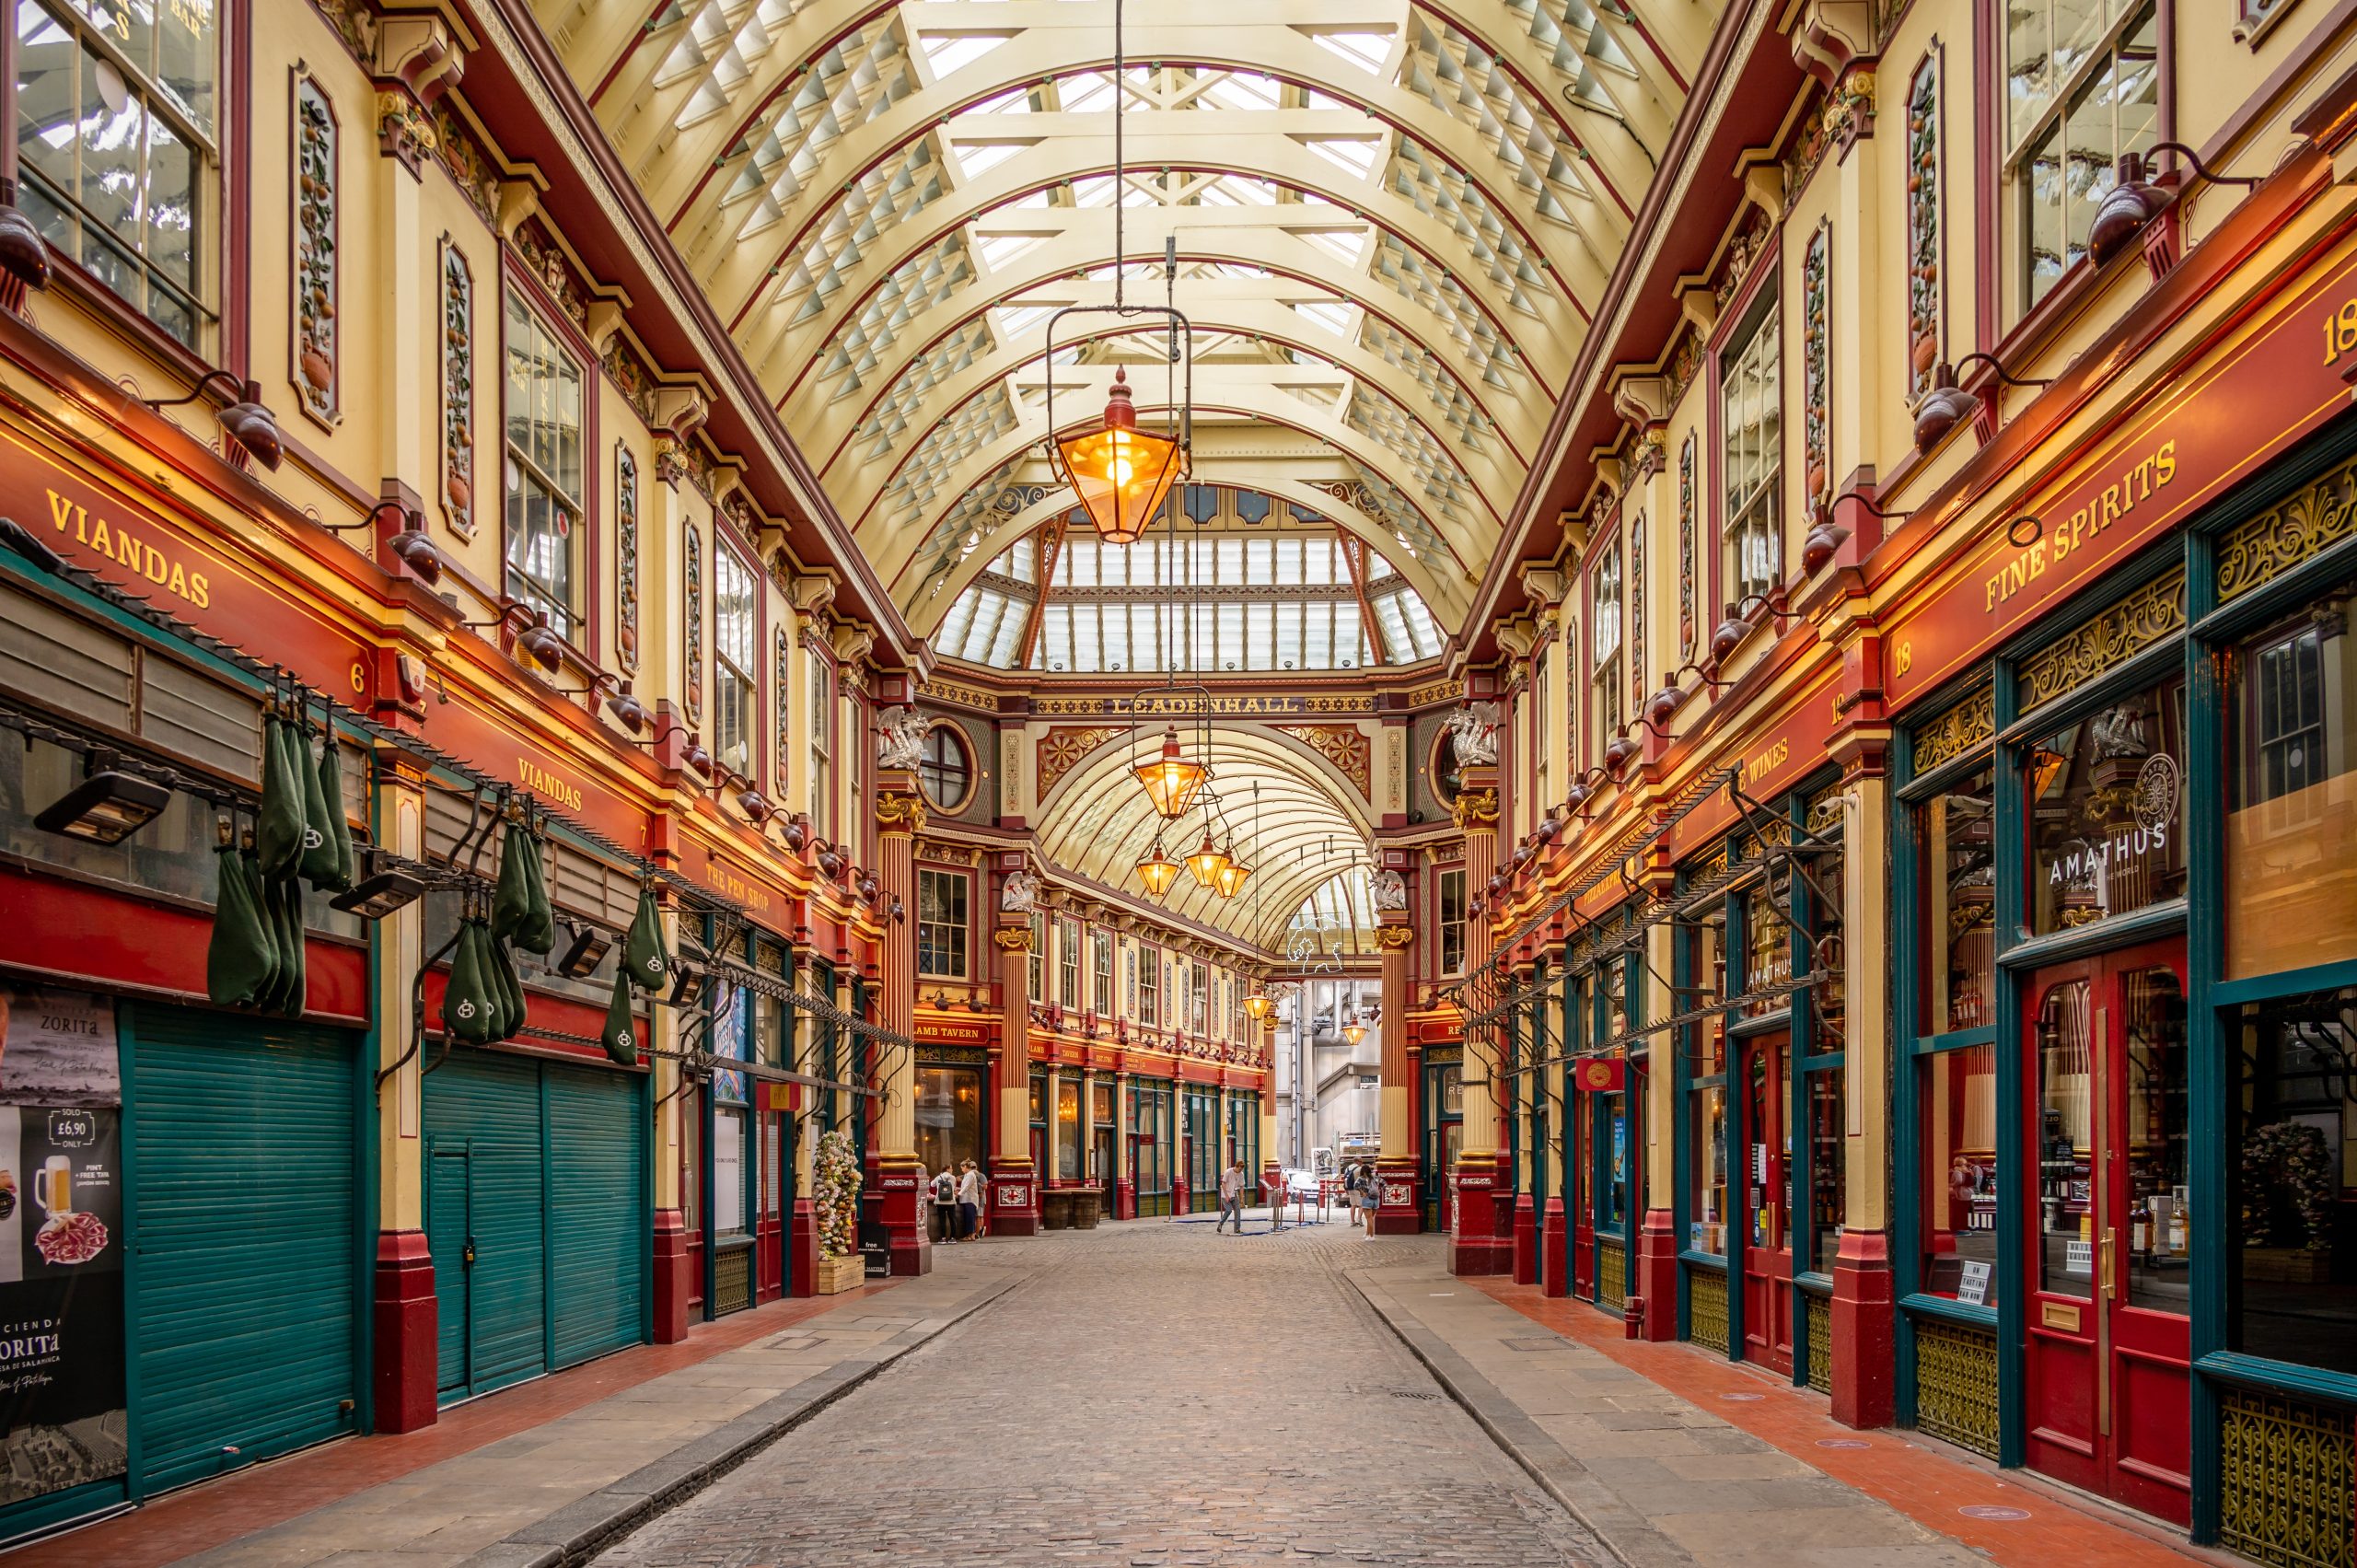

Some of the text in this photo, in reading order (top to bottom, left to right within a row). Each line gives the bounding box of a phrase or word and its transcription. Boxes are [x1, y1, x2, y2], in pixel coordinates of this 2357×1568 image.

[511, 369, 526, 393] BAR
[540, 338, 549, 465] BROKERS
[1985, 438, 2177, 613] FINE SPIRITS
[46, 488, 210, 609] VIANDAS
[1895, 641, 1911, 678] 18
[351, 663, 365, 694] 6
[1112, 697, 1299, 714] LEADENHALL
[1720, 737, 1789, 807] FIE WINES
[517, 757, 582, 812] VIANDAS
[640, 824, 647, 847] 7
[2049, 821, 2165, 886] AMATHUS
[2118, 865, 2140, 878] WORLD
[705, 863, 769, 912] THE PEN SHOP
[940, 1028, 980, 1038] TAVERN
[1030, 1045, 1045, 1054] LAMB
[1062, 1050, 1079, 1059] TAVERN
[58, 1121, 87, 1136] £6,90
[1972, 1266, 1980, 1274] ON
[1963, 1277, 1985, 1289] TASTING
